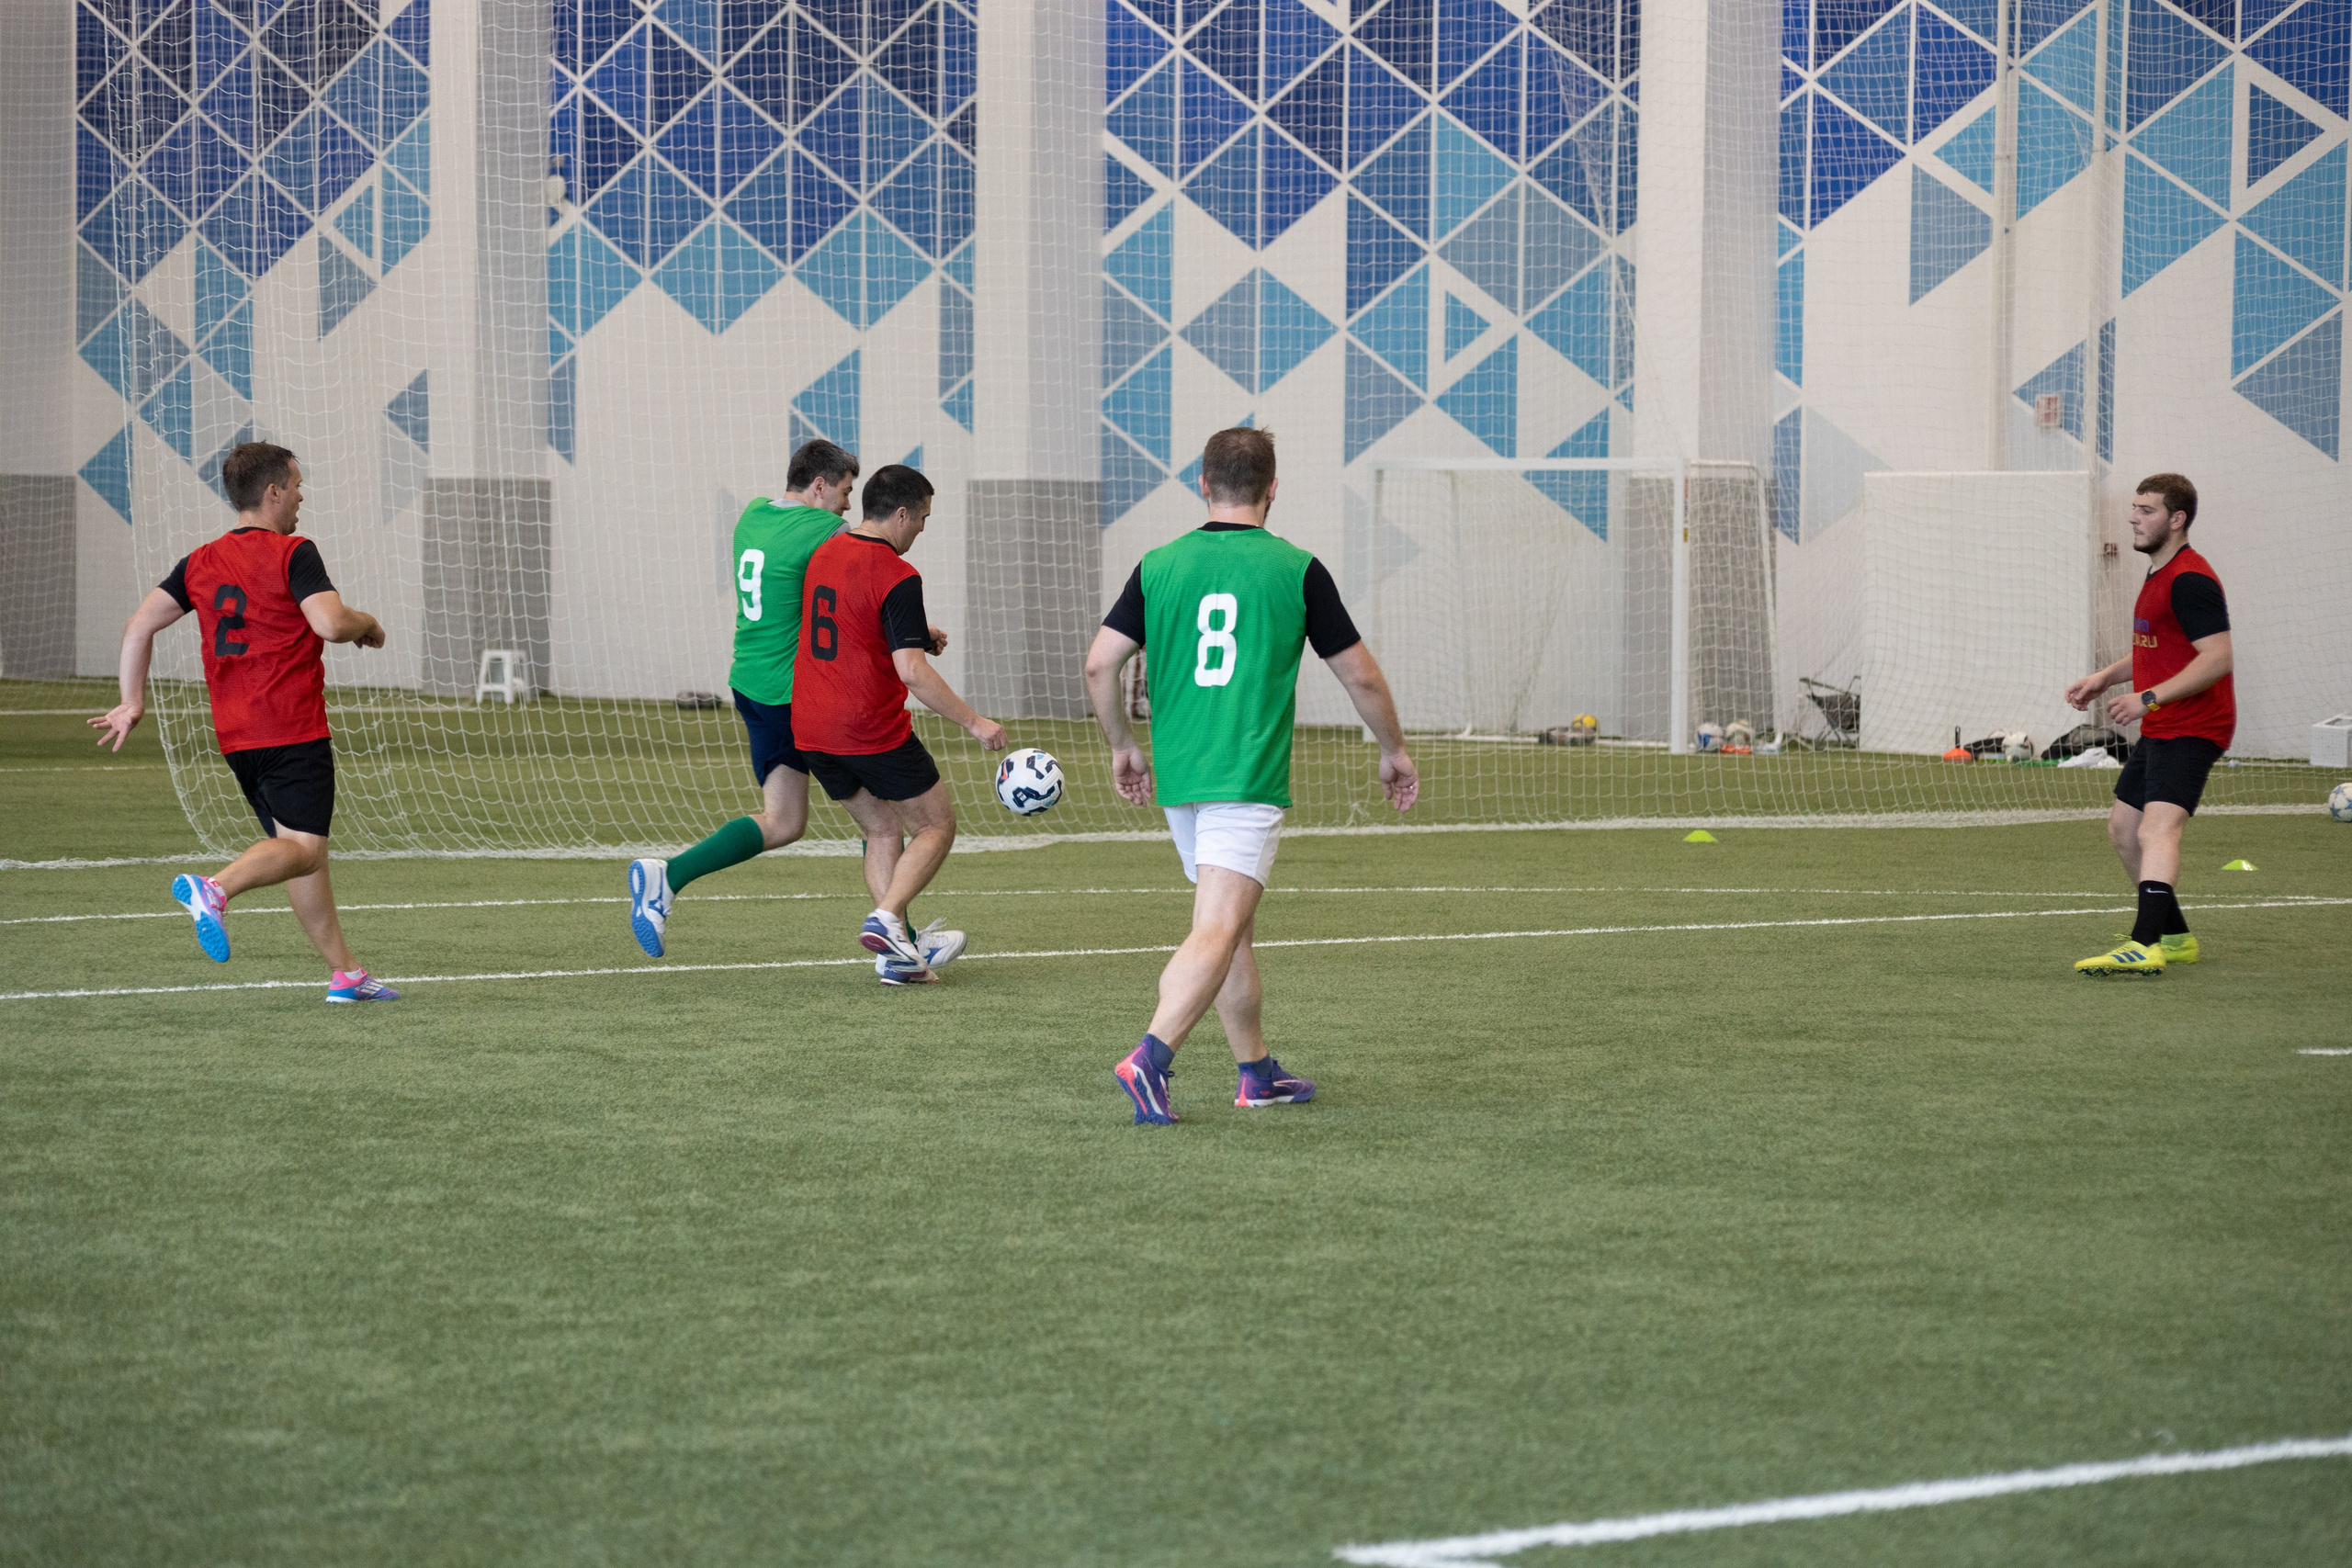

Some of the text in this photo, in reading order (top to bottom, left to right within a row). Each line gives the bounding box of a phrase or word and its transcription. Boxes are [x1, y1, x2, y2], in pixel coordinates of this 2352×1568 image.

[213, 583, 250, 658] 2
[738, 549, 765, 622] 9
[810, 584, 839, 661] 6
[1194, 592, 1238, 687] 8
